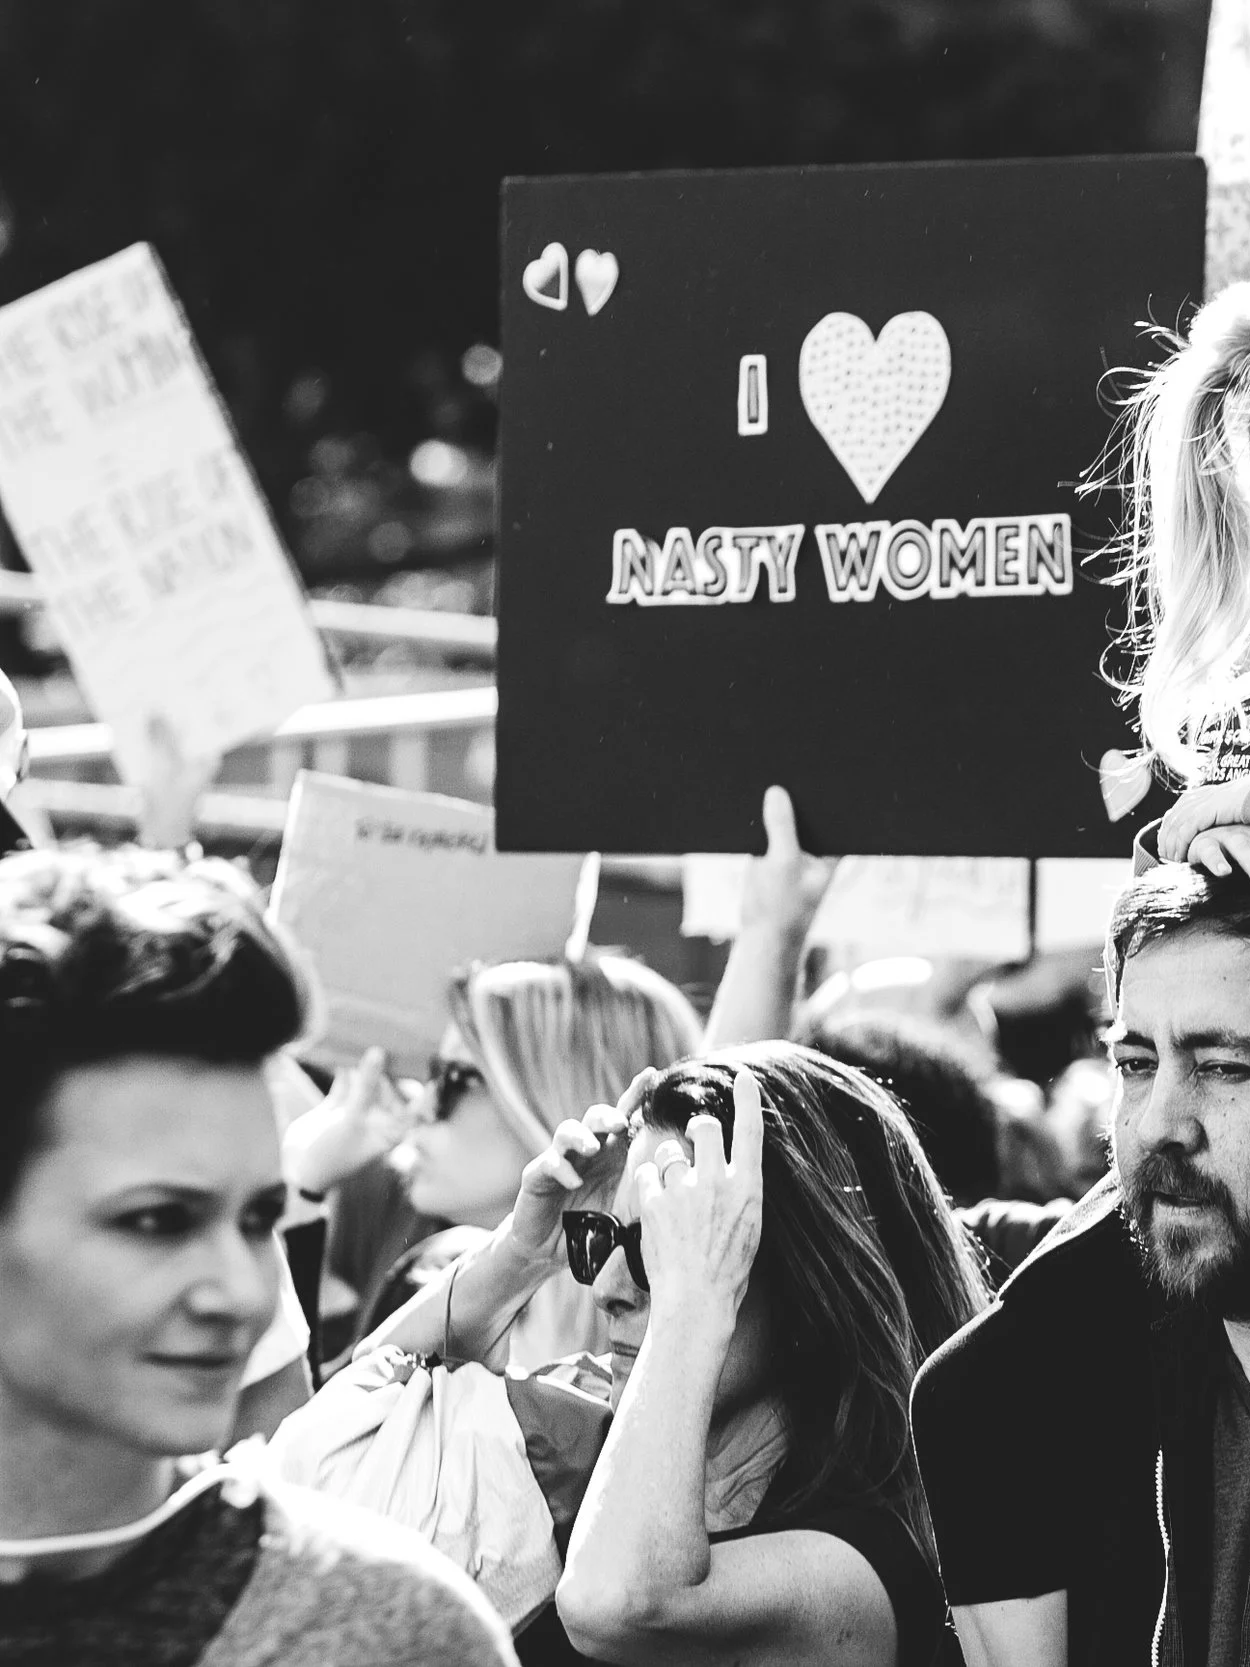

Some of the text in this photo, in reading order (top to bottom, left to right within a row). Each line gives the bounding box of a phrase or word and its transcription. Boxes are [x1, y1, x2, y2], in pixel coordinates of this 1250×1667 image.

[737, 354, 769, 436] I
[605, 513, 1075, 606] NASTY WOMEN
